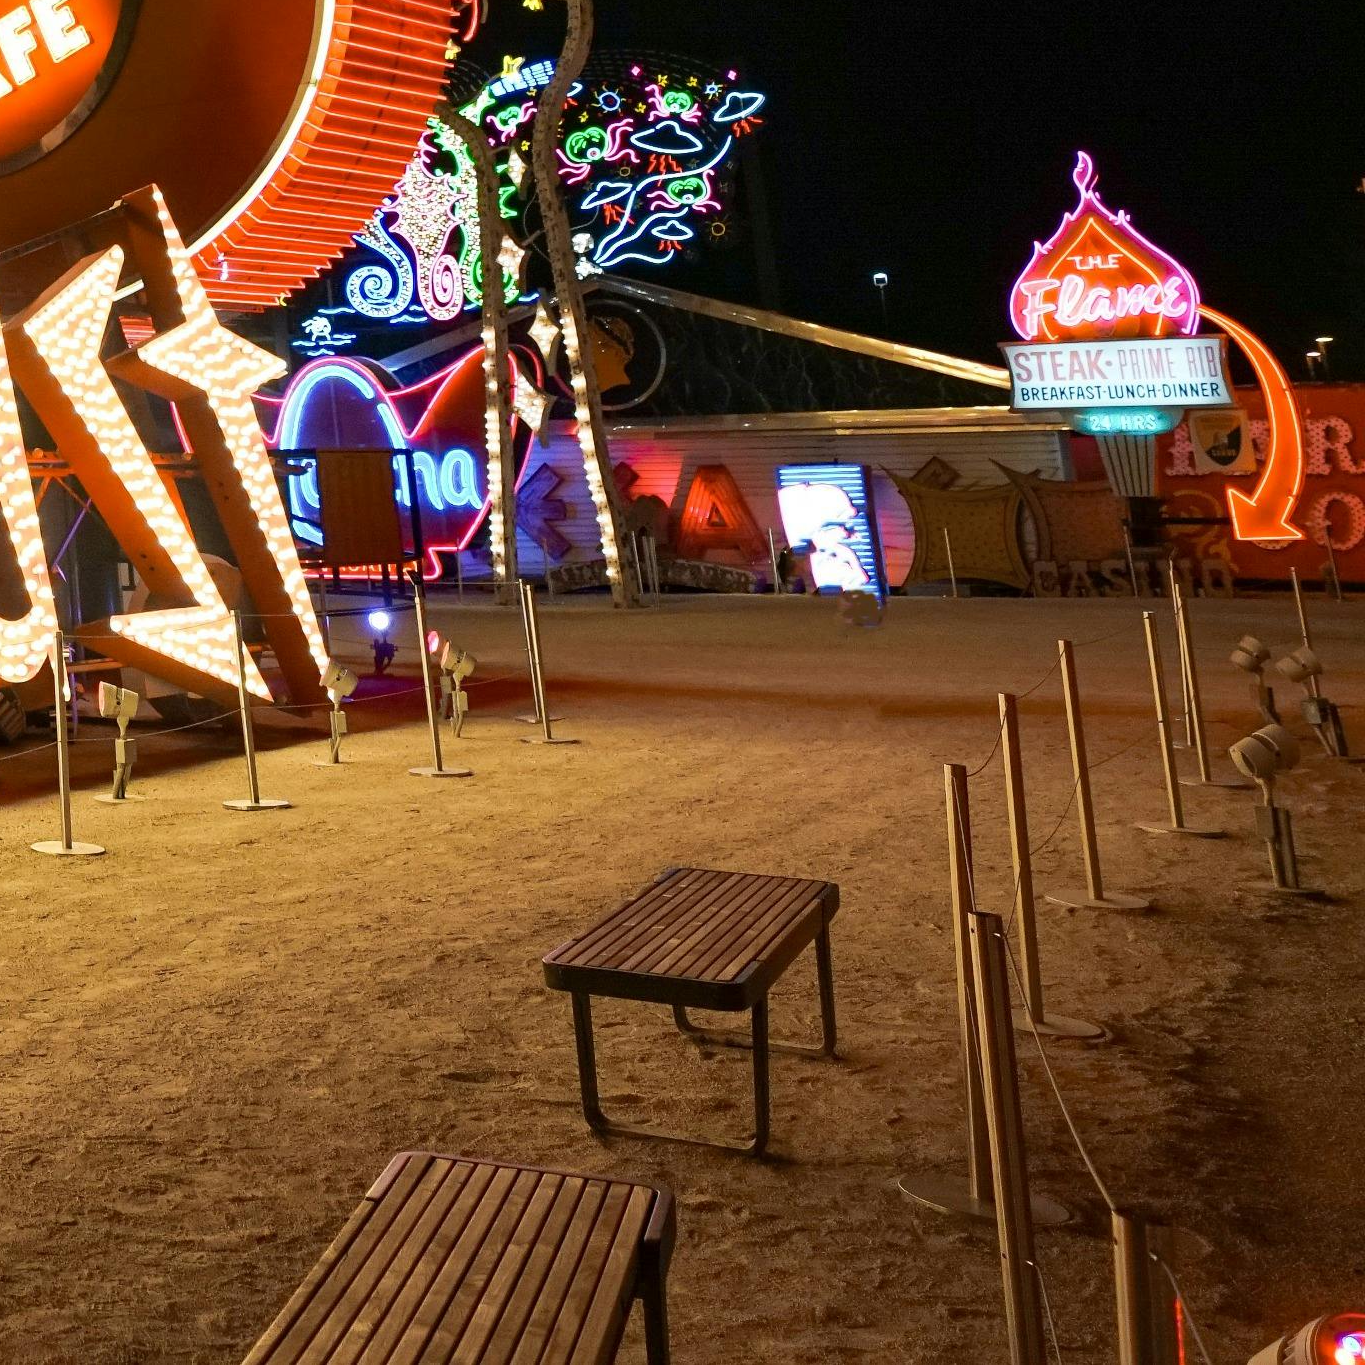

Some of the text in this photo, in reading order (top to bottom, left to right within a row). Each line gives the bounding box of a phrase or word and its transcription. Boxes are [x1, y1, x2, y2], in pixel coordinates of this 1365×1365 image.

[1067, 253, 1124, 270] THE
[1019, 274, 1188, 337] Flame
[1013, 345, 1219, 383] STEAK PRIME RIB
[1089, 414, 1158, 432] 24 HRS
[1032, 558, 1234, 598] CASINO
